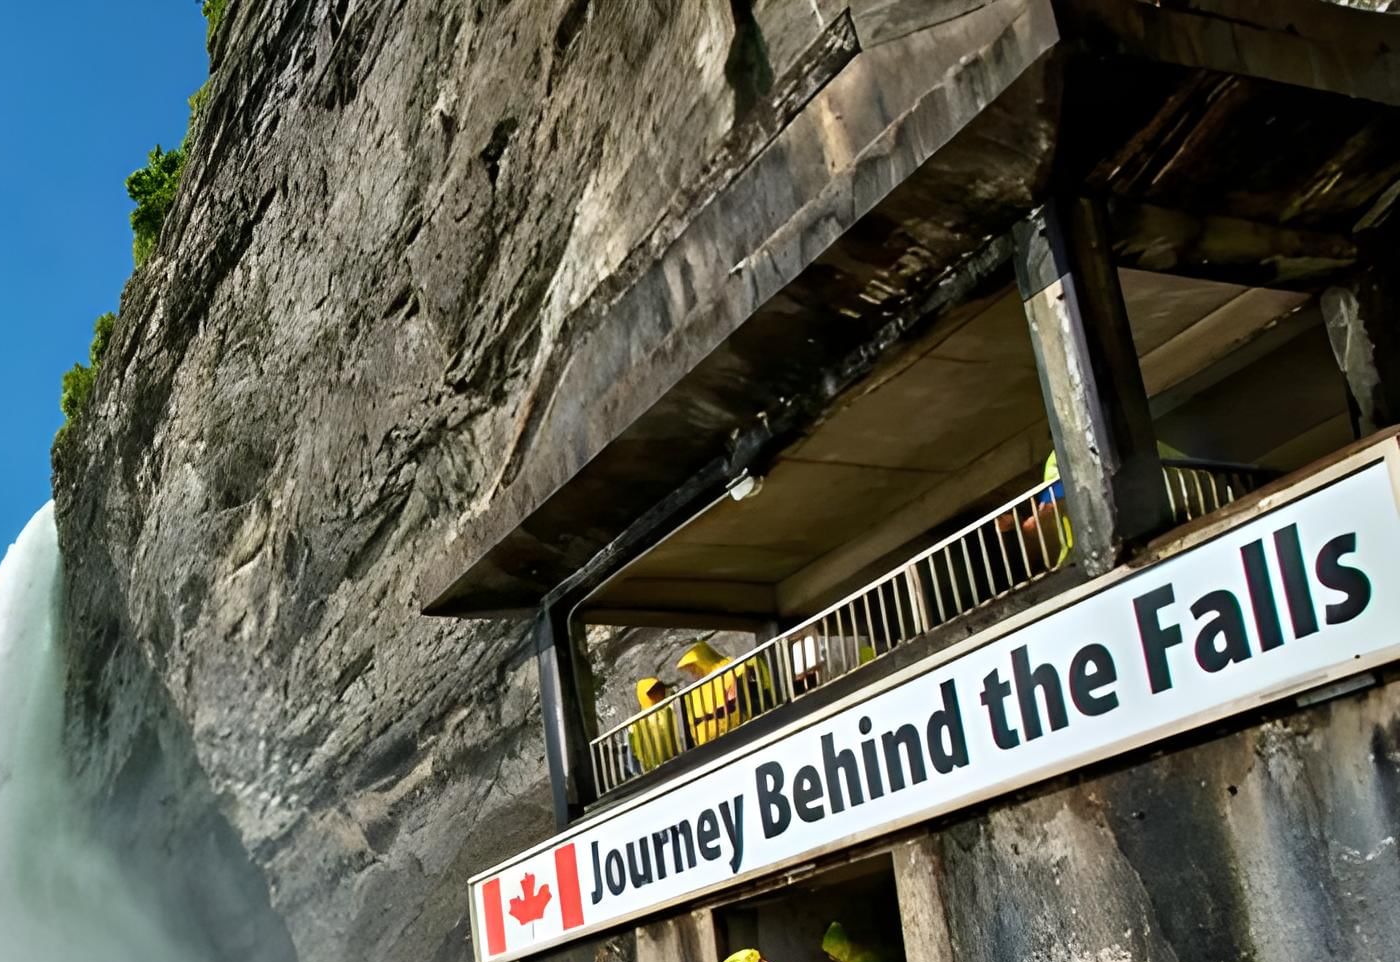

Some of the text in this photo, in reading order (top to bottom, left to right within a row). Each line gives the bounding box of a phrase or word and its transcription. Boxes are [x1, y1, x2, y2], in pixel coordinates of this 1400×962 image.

[590, 522, 1372, 905] Journey Behind the Falls
